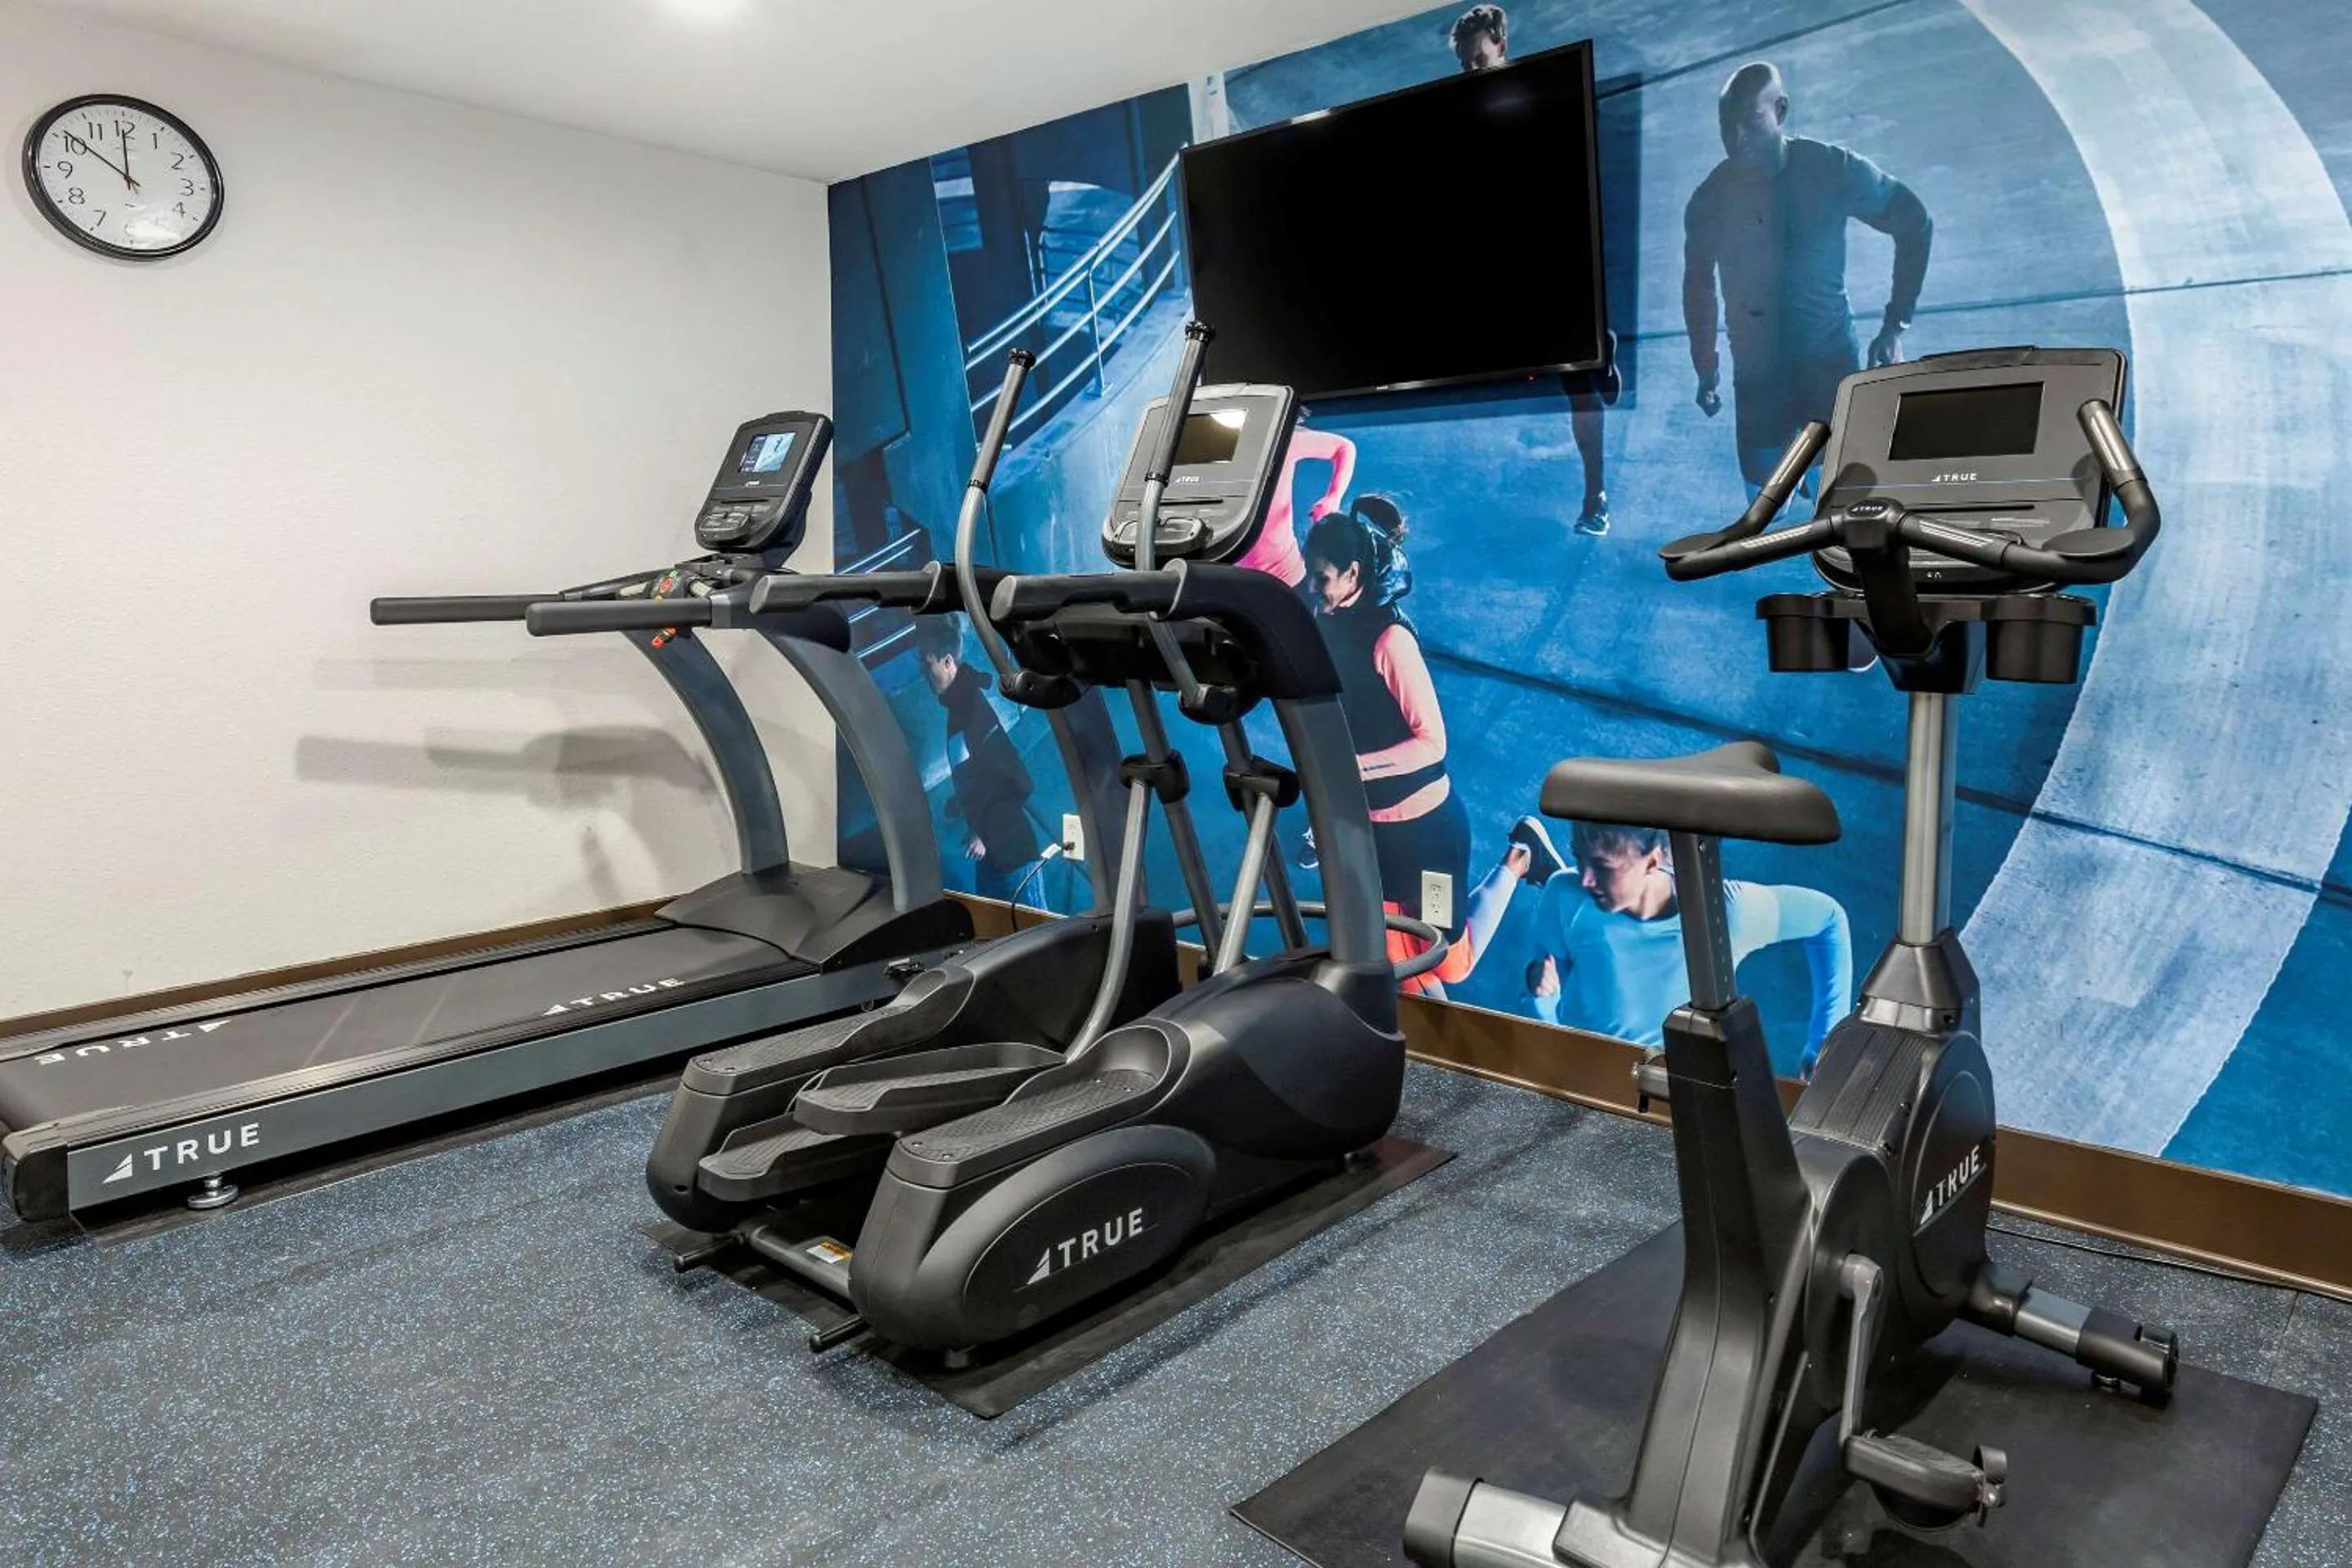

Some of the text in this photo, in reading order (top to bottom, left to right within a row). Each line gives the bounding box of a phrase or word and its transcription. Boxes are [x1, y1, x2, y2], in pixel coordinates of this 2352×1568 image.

[88, 122, 103, 140] 11
[114, 120, 136, 140] 12
[65, 135, 87, 155] 10
[152, 132, 158, 149] 1
[57, 161, 74, 178] 9
[171, 151, 185, 170] 2
[69, 186, 85, 204] 8
[180, 178, 194, 197] 3
[94, 209, 107, 227] 7
[172, 202, 186, 218] 4
[1943, 473, 1977, 482] TRUE
[569, 978, 686, 1006] TRUE
[34, 1031, 193, 1065] TRUE
[143, 1122, 260, 1170] TRUE
[1936, 1144, 1980, 1207] TRUE
[1058, 1207, 1143, 1268] TRUE
